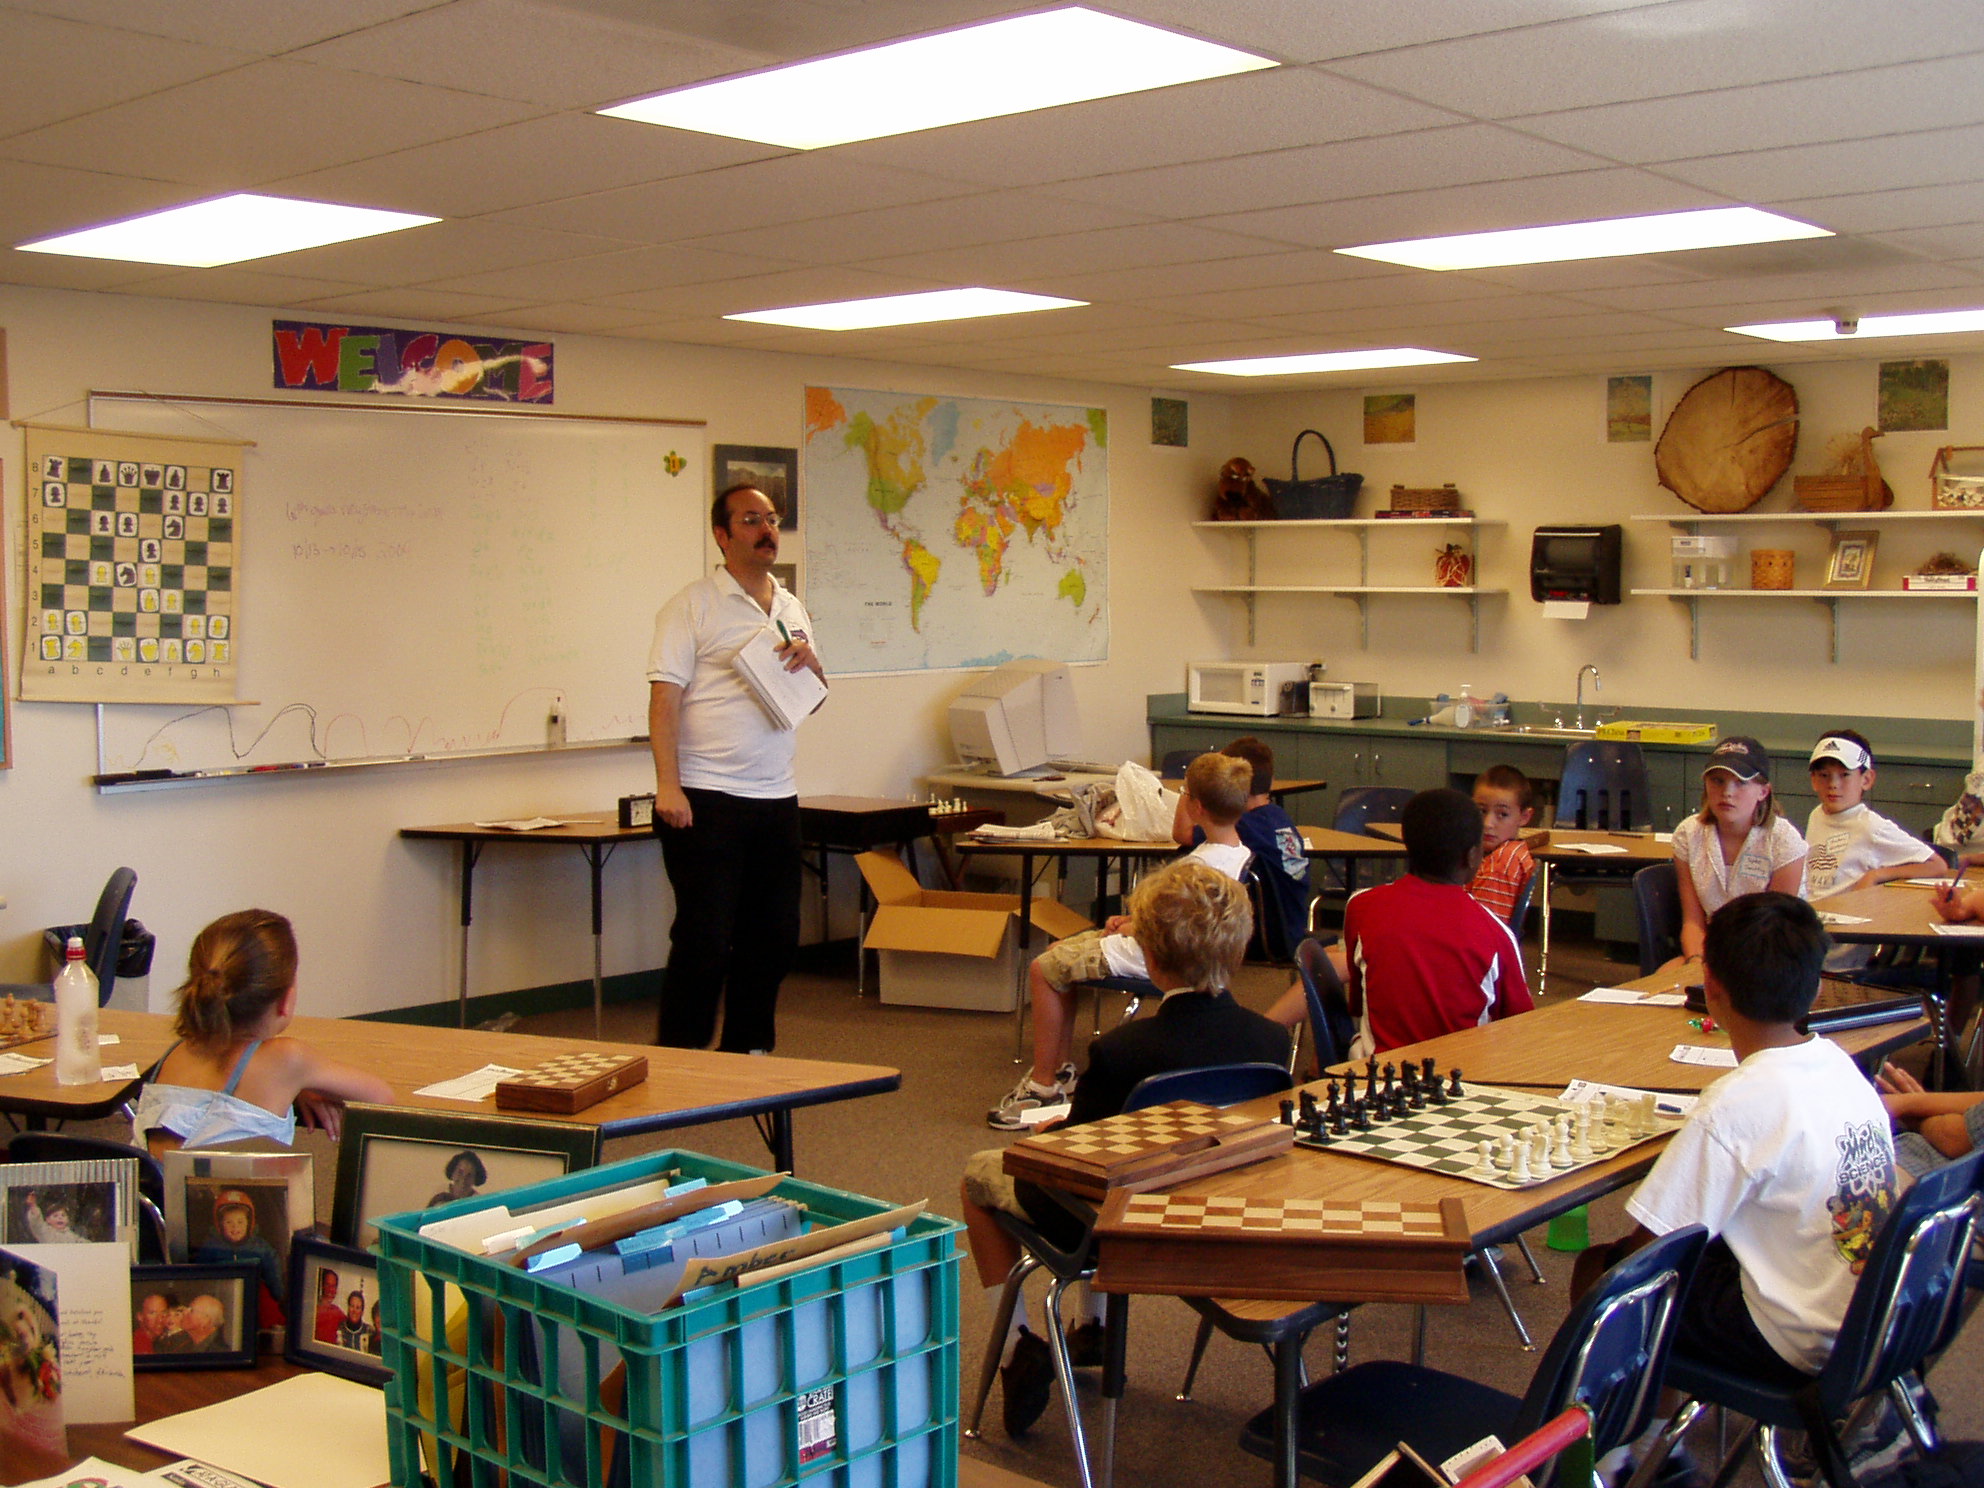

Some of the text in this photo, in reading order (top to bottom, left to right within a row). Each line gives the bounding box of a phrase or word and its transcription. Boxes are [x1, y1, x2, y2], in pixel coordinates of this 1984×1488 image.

[274, 327, 552, 400] WELCOME
[1838, 1152, 1887, 1185] SCIENCE
[695, 1248, 797, 1286] Amber
[807, 1389, 834, 1408] CRATE
